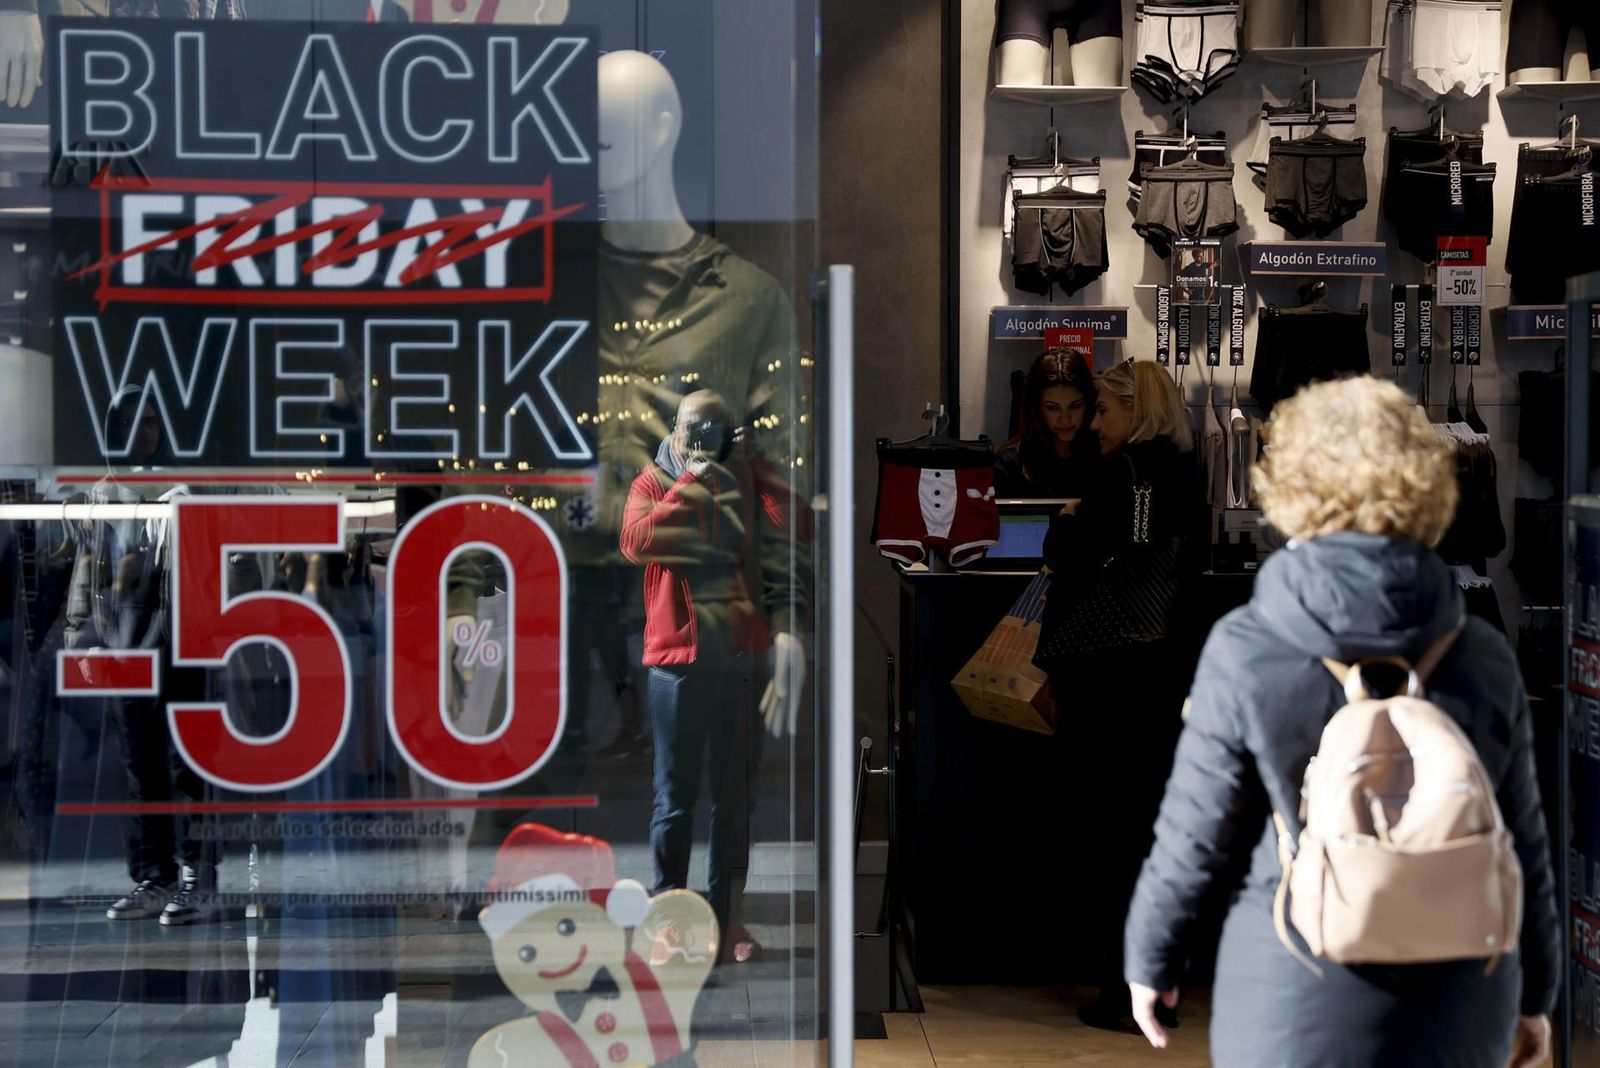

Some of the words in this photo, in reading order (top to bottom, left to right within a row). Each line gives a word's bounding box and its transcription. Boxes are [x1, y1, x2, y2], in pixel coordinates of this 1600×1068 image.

[60, 29, 592, 164] BLACK
[1450, 161, 1463, 205] MICRORED
[1582, 172, 1595, 226] MICROFIBRA
[121, 194, 531, 288] FRIDAY
[1259, 251, 1313, 267] Algodón
[1316, 252, 1377, 267] Extrafino
[1440, 251, 1469, 259] CAMISETAS
[1158, 287, 1170, 321] ALGODON
[1232, 285, 1244, 306] 100%
[1446, 279, 1477, 295] -50%
[1005, 317, 1059, 333] Algodón
[1059, 334, 1081, 343] PRECIO
[1157, 321, 1169, 350] SUPIMA
[1178, 307, 1190, 348] ALGODON
[1208, 320, 1220, 348] SUPIMA
[1231, 308, 1244, 348] ALGODON
[1394, 301, 1406, 348] EXTRAFINO
[1420, 300, 1431, 347] EXTRAFINO
[1452, 305, 1464, 347] ROFIBRA
[64, 316, 594, 460] WEEK
[221, 818, 314, 839] artículos
[319, 818, 466, 839] seleccionados
